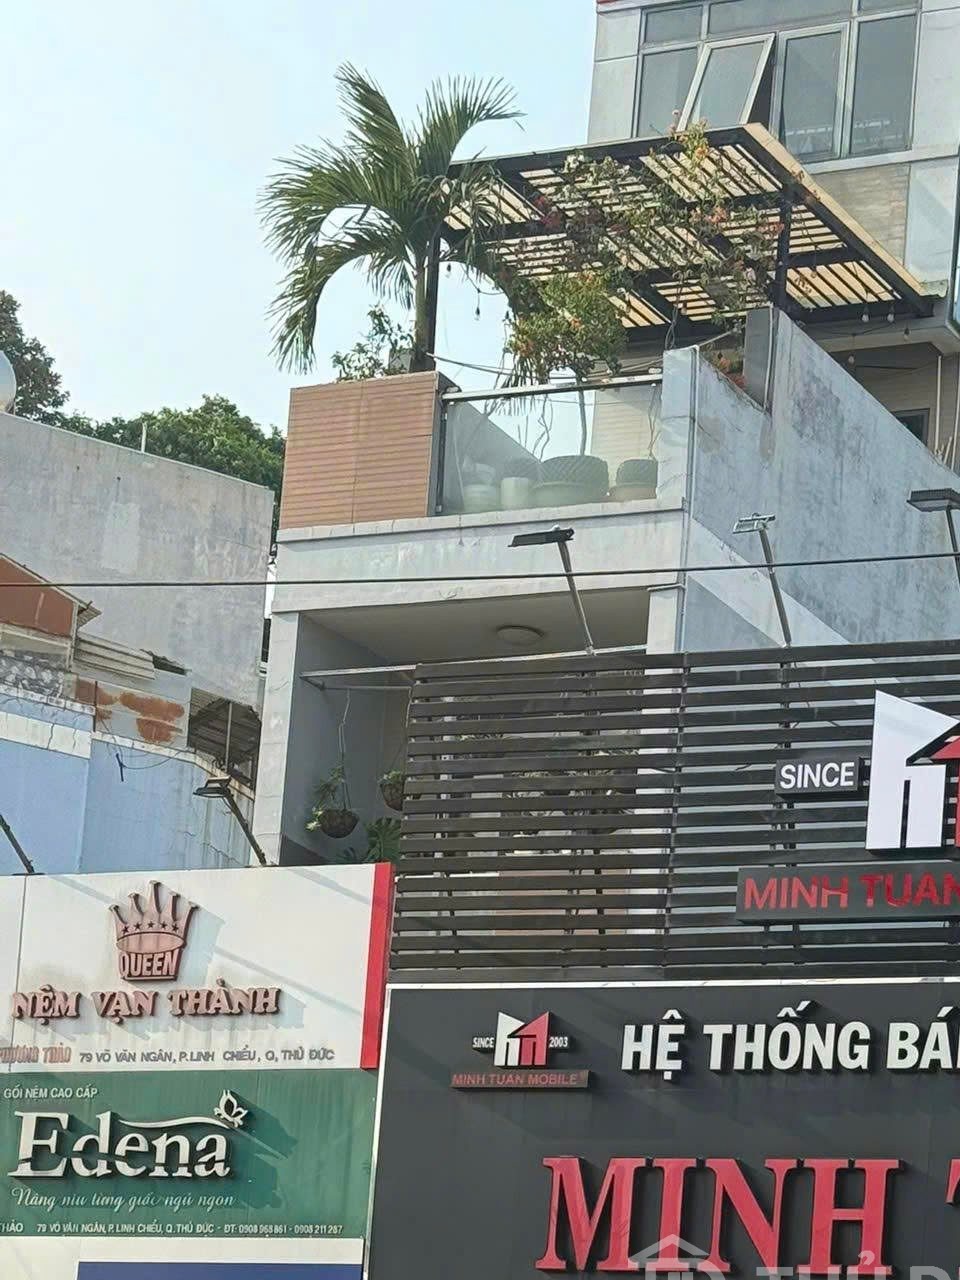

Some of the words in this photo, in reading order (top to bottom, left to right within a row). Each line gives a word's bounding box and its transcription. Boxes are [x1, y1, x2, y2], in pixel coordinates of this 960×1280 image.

[779, 761, 855, 790] SINCE
[743, 876, 849, 910] MINH
[118, 952, 179, 979] QUEEN
[11, 985, 81, 1026] NỆM
[91, 990, 158, 1025] VẠN
[472, 1037, 495, 1048] SINCE
[549, 1036, 569, 1047] 2003
[621, 1009, 685, 1080] HỆ
[704, 1001, 871, 1073] THỐNG
[80, 1052, 92, 1063] 79
[96, 1049, 111, 1063] VÕ
[115, 1050, 136, 1062] VĂN
[141, 1049, 177, 1064] NGÂN,
[309, 1047, 335, 1060] ĐỨC
[3, 1084, 23, 1099] GỐI
[25, 1085, 48, 1101] NỆM
[51, 1088, 72, 1098] CAO
[76, 1083, 98, 1099] CẤP
[528, 1073, 577, 1085] MOBILE
[7, 1110, 231, 1177] Edena
[11, 1187, 56, 1212] Nâng
[535, 1156, 900, 1275] MINH
